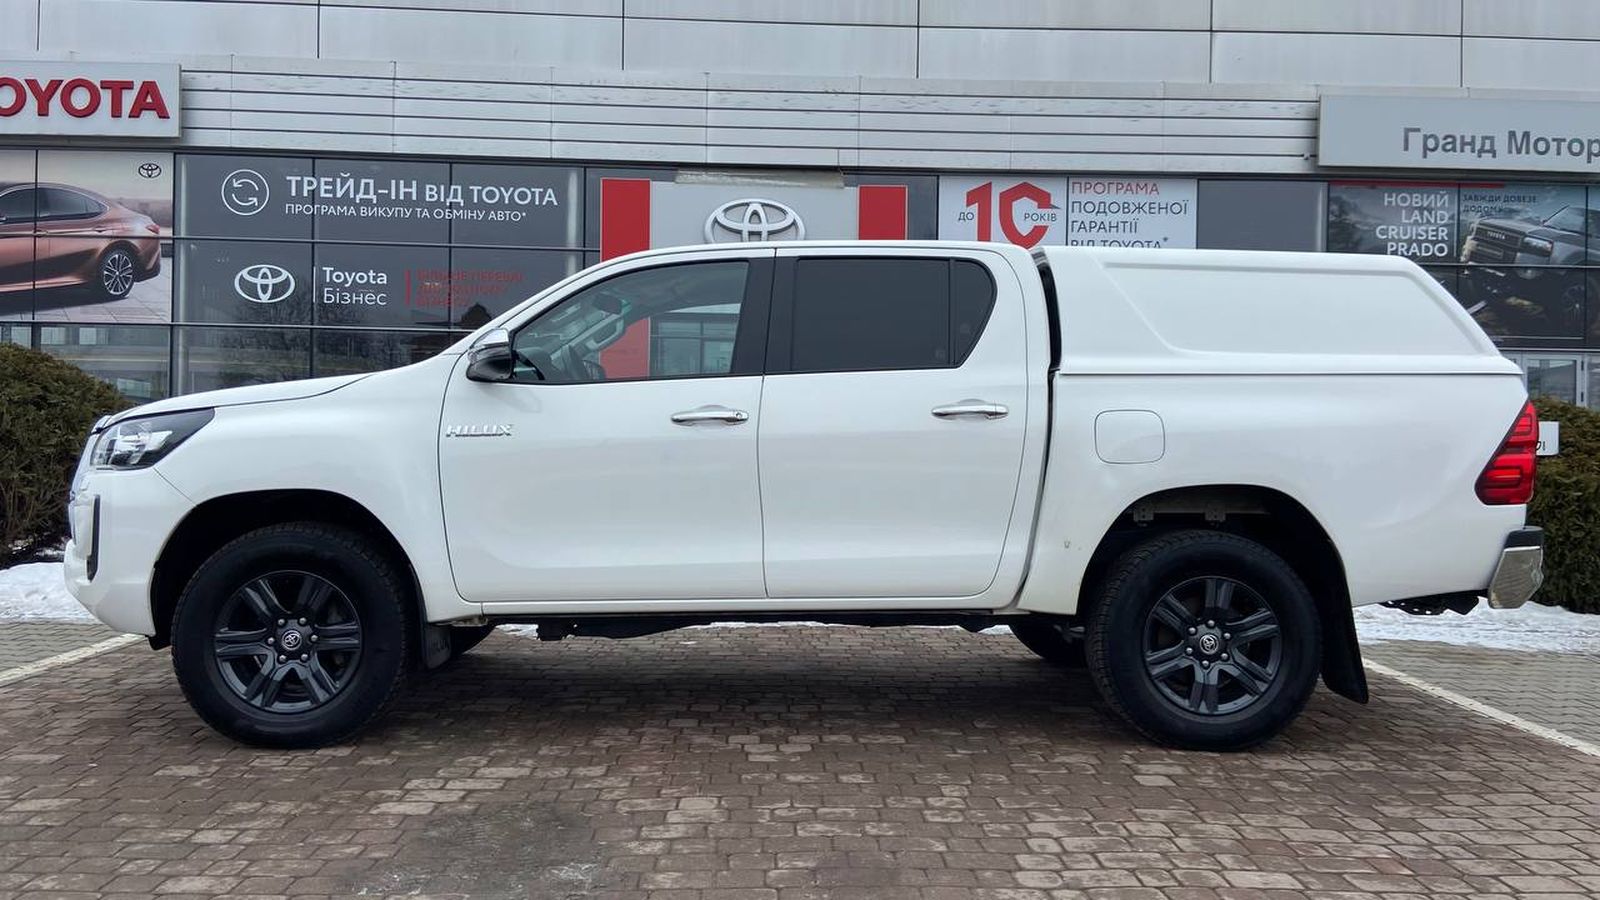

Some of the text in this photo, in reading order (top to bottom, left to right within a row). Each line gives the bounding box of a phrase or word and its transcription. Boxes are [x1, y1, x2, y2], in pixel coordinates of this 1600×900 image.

[1403, 127, 1600, 164] Гранд Мотор
[286, 172, 559, 207] ТРЕЙД-ІН ВІД TOYOTA
[1071, 181, 1160, 196] ПРОГРАМА
[1384, 190, 1449, 208] НОВИЙ
[285, 203, 357, 217] ПРОГРАМА
[360, 206, 413, 219] ВИКУПУ
[415, 207, 430, 219] ТА
[433, 208, 486, 221] ОБМІНУ
[1071, 199, 1190, 217] ПОДОВЖЕНОЇ
[1402, 209, 1449, 224] LAND
[958, 211, 975, 222] ДО
[1023, 212, 1057, 223] РОКІВ
[1071, 218, 1140, 234] ГАРАНТІЇ
[1375, 225, 1449, 241] CRUISER
[1387, 242, 1449, 257] PRADO
[322, 266, 388, 288] Toyota
[323, 287, 387, 306] Бізнес
[446, 424, 513, 438] HILUX
